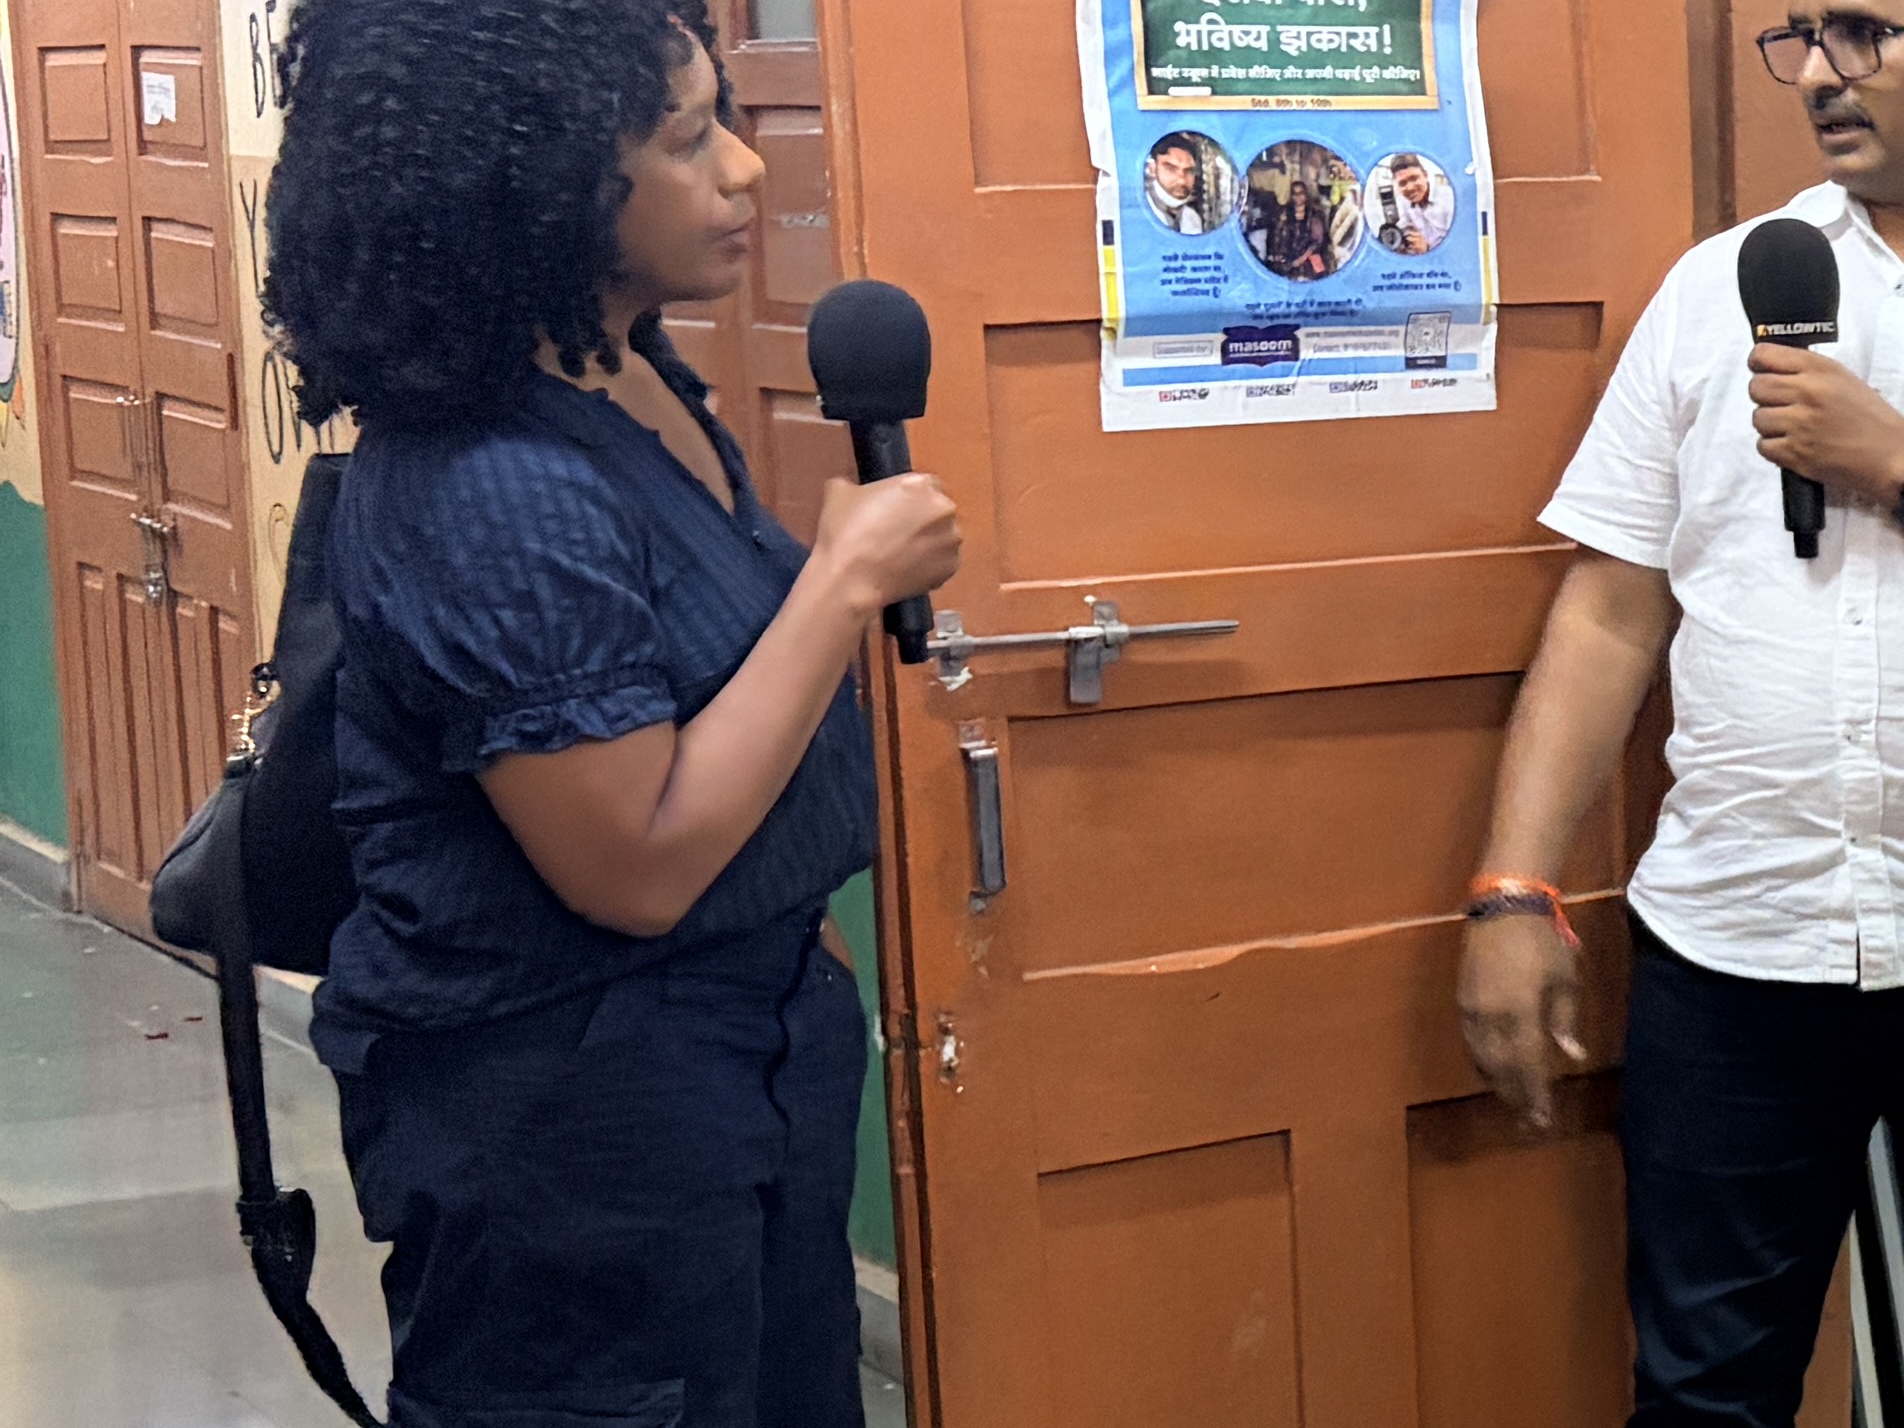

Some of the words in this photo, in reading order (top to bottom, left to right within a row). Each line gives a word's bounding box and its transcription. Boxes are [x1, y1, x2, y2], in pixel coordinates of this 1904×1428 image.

[1174, 11, 1270, 51] भविष्य
[1276, 24, 1392, 56] झकास!
[1229, 339, 1292, 352] masoom
